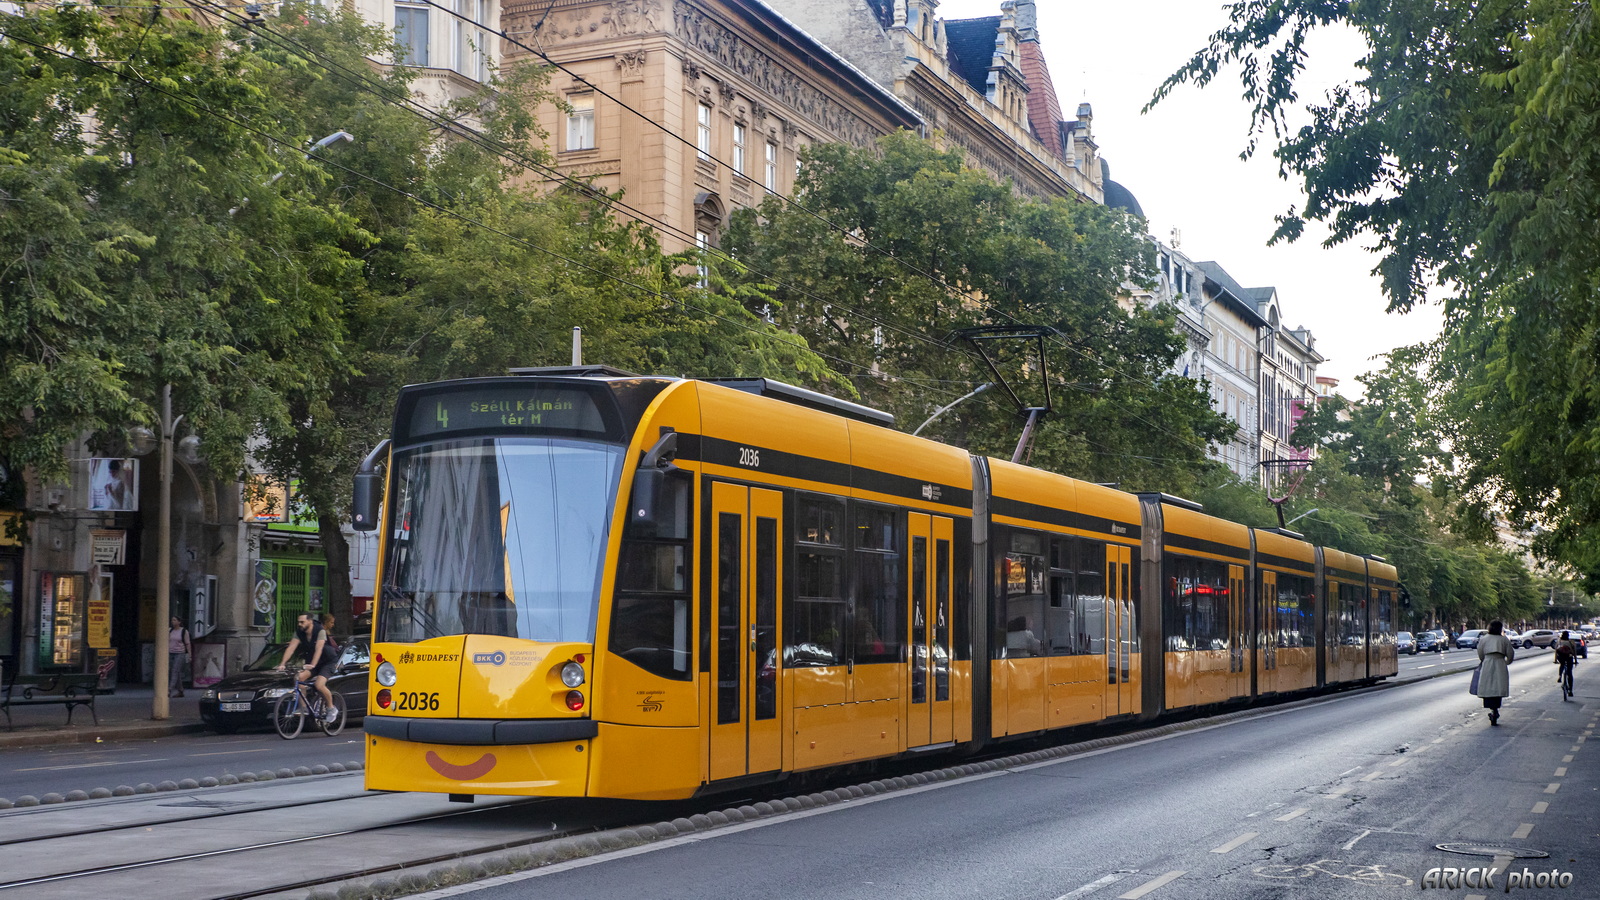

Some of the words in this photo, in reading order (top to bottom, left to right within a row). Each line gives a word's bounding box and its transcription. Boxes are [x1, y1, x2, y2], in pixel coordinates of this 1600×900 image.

[470, 399, 510, 413] Széll
[516, 398, 573, 412] Kálmán
[437, 401, 449, 428] 4
[501, 412, 524, 425] tér
[531, 413, 541, 425] M
[739, 446, 760, 467] 2036
[416, 653, 460, 662] BUDAPEST
[398, 691, 440, 711] 2036
